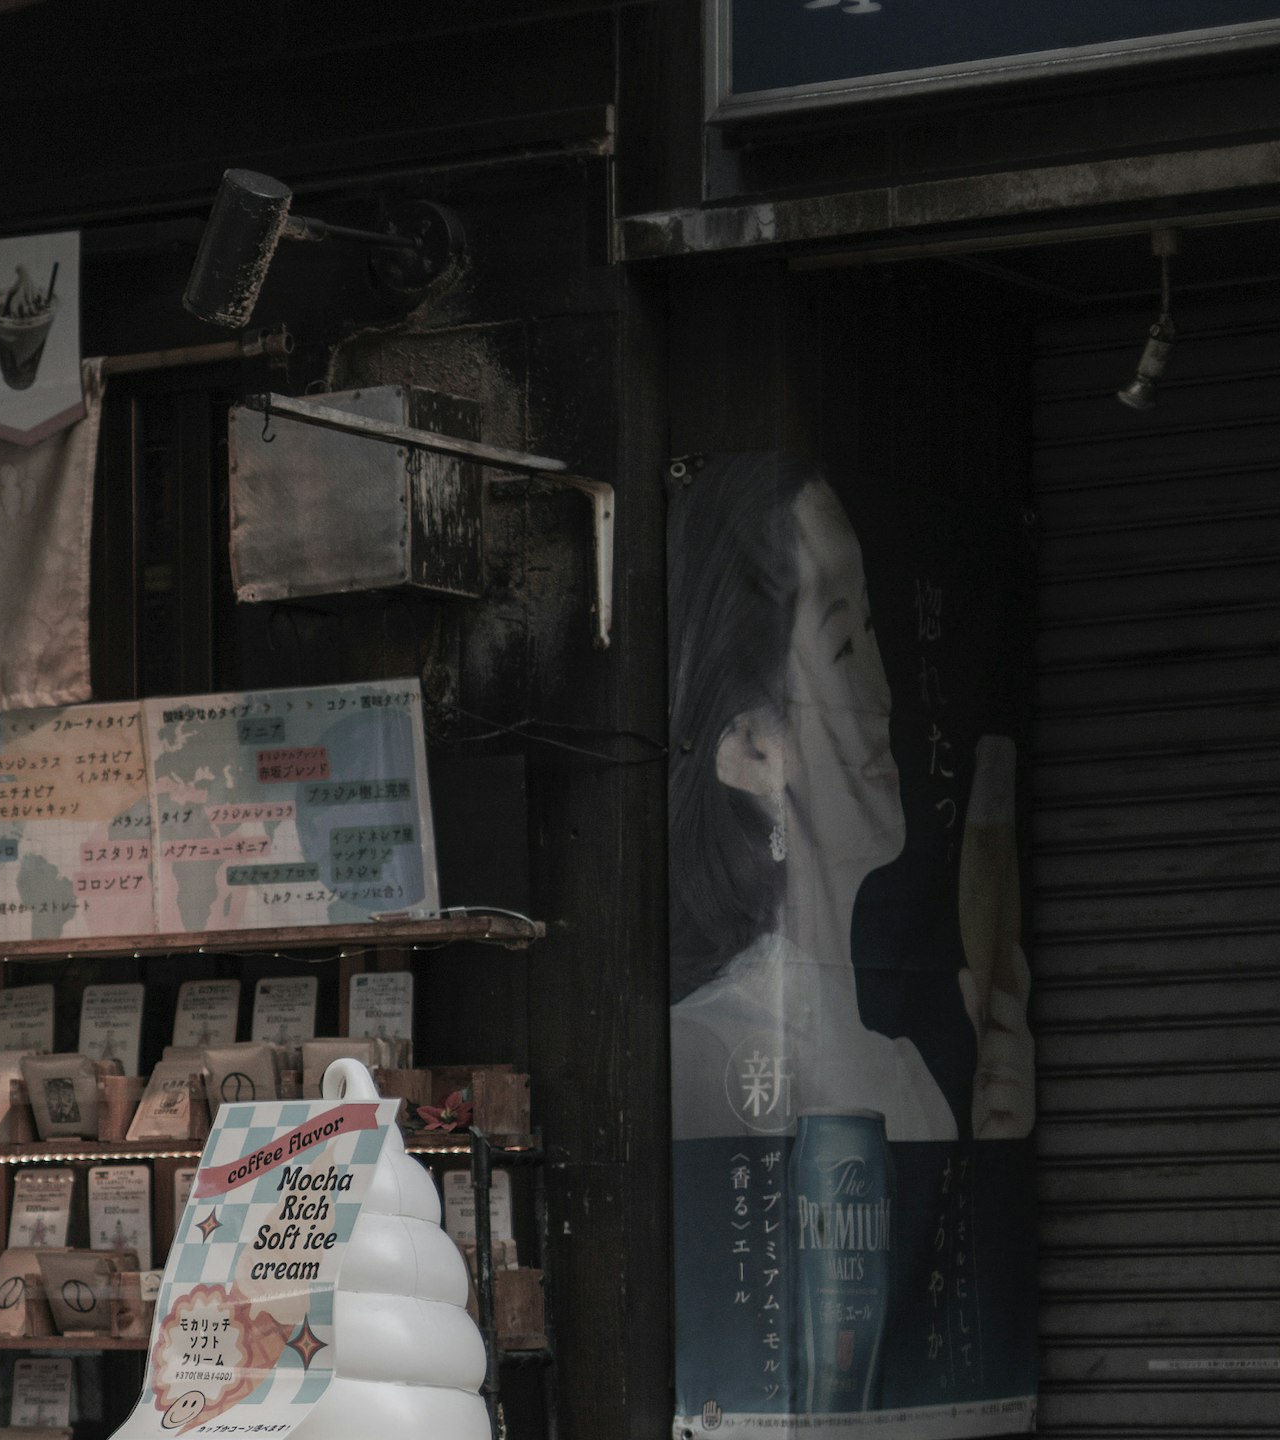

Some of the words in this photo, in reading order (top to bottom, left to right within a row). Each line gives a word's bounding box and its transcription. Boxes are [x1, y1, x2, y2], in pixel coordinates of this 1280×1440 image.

[52, 713, 138, 732] フルーティタイプ
[74, 749, 134, 766] エチオピア
[82, 846, 150, 864] コスタリカ
[76, 874, 145, 892] コロンビア
[740, 1049, 796, 1119] 新
[227, 1147, 284, 1185] coffee
[287, 1116, 345, 1156] flavor
[276, 1165, 354, 1192] Mocha
[821, 1154, 874, 1198] The
[278, 1194, 330, 1221] Rich
[728, 1151, 753, 1306] 〈香る〉エール
[797, 1194, 891, 1251] PREMIUM
[253, 1223, 301, 1250] Soft
[303, 1223, 338, 1250] ice
[251, 1261, 320, 1281] cream
[760, 1150, 782, 1402] ザ・プレミアム・モルツ
[180, 1317, 231, 1332] モカリッチ
[189, 1335, 220, 1349] ソフト
[180, 1352, 225, 1367] クリーム
